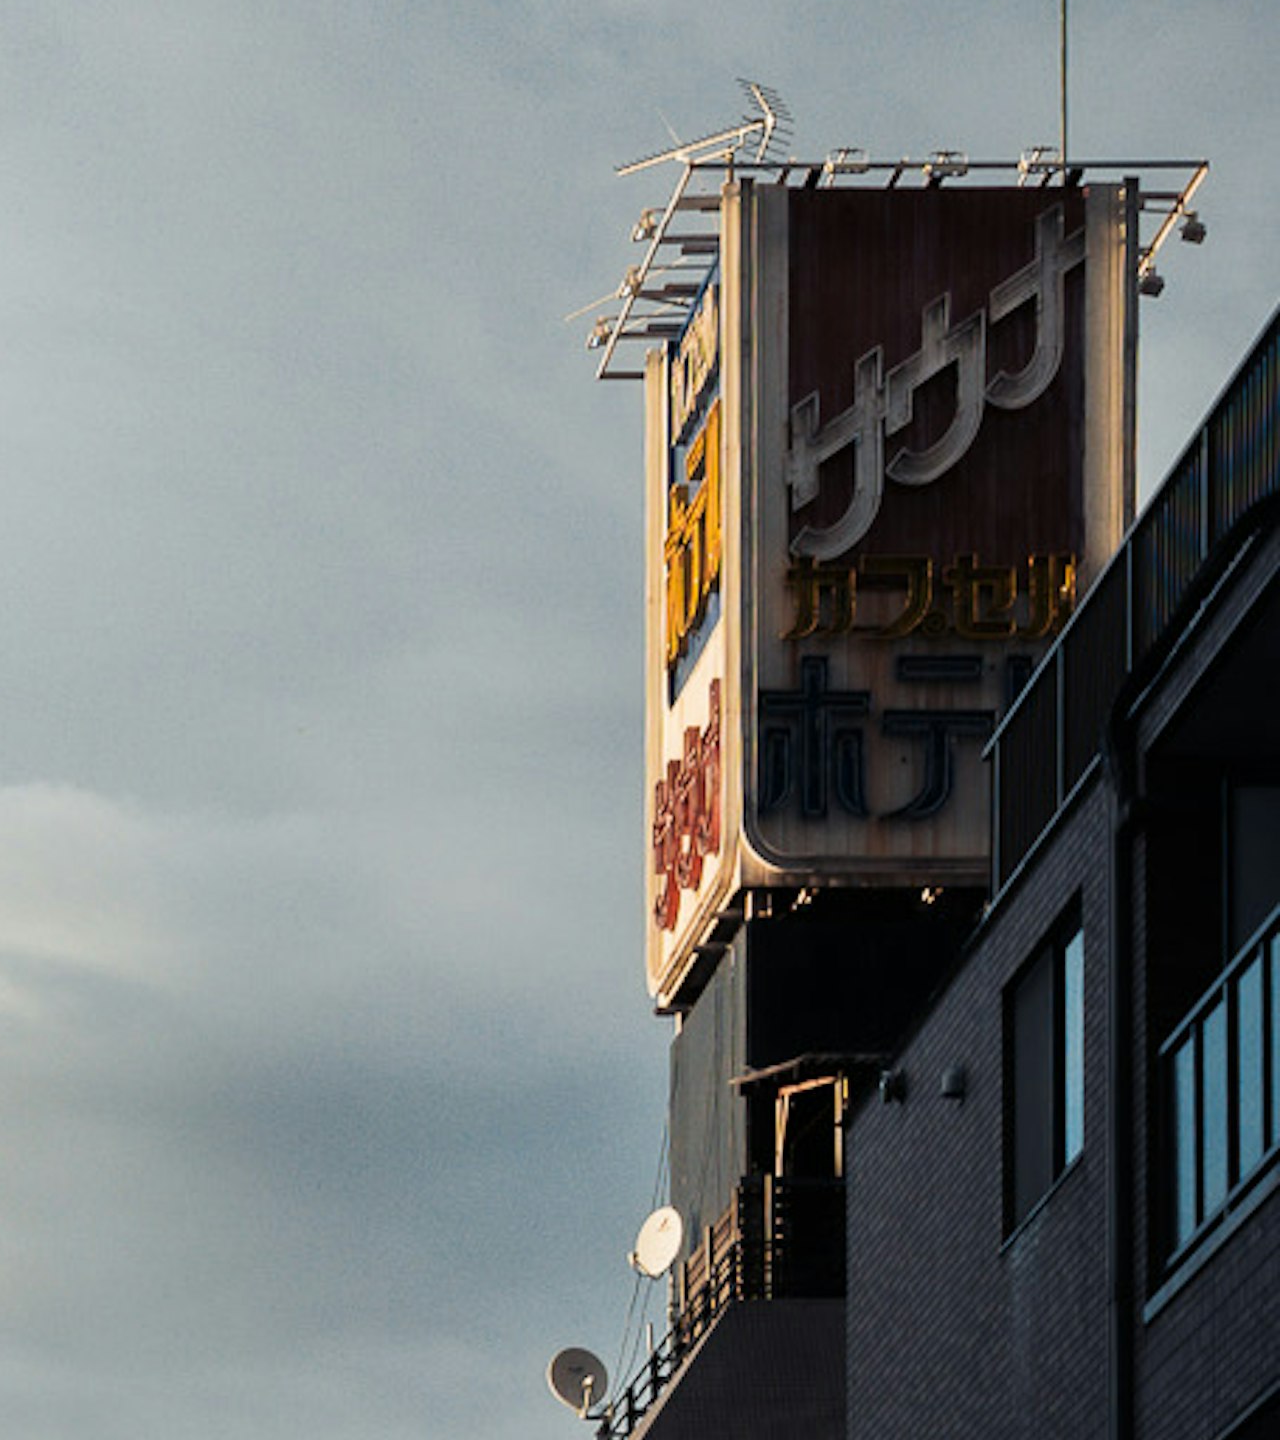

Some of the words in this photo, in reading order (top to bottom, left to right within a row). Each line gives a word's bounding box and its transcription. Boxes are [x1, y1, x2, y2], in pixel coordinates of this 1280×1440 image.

[787, 204, 1086, 560] サウナ
[758, 655, 1032, 821] ホテ
